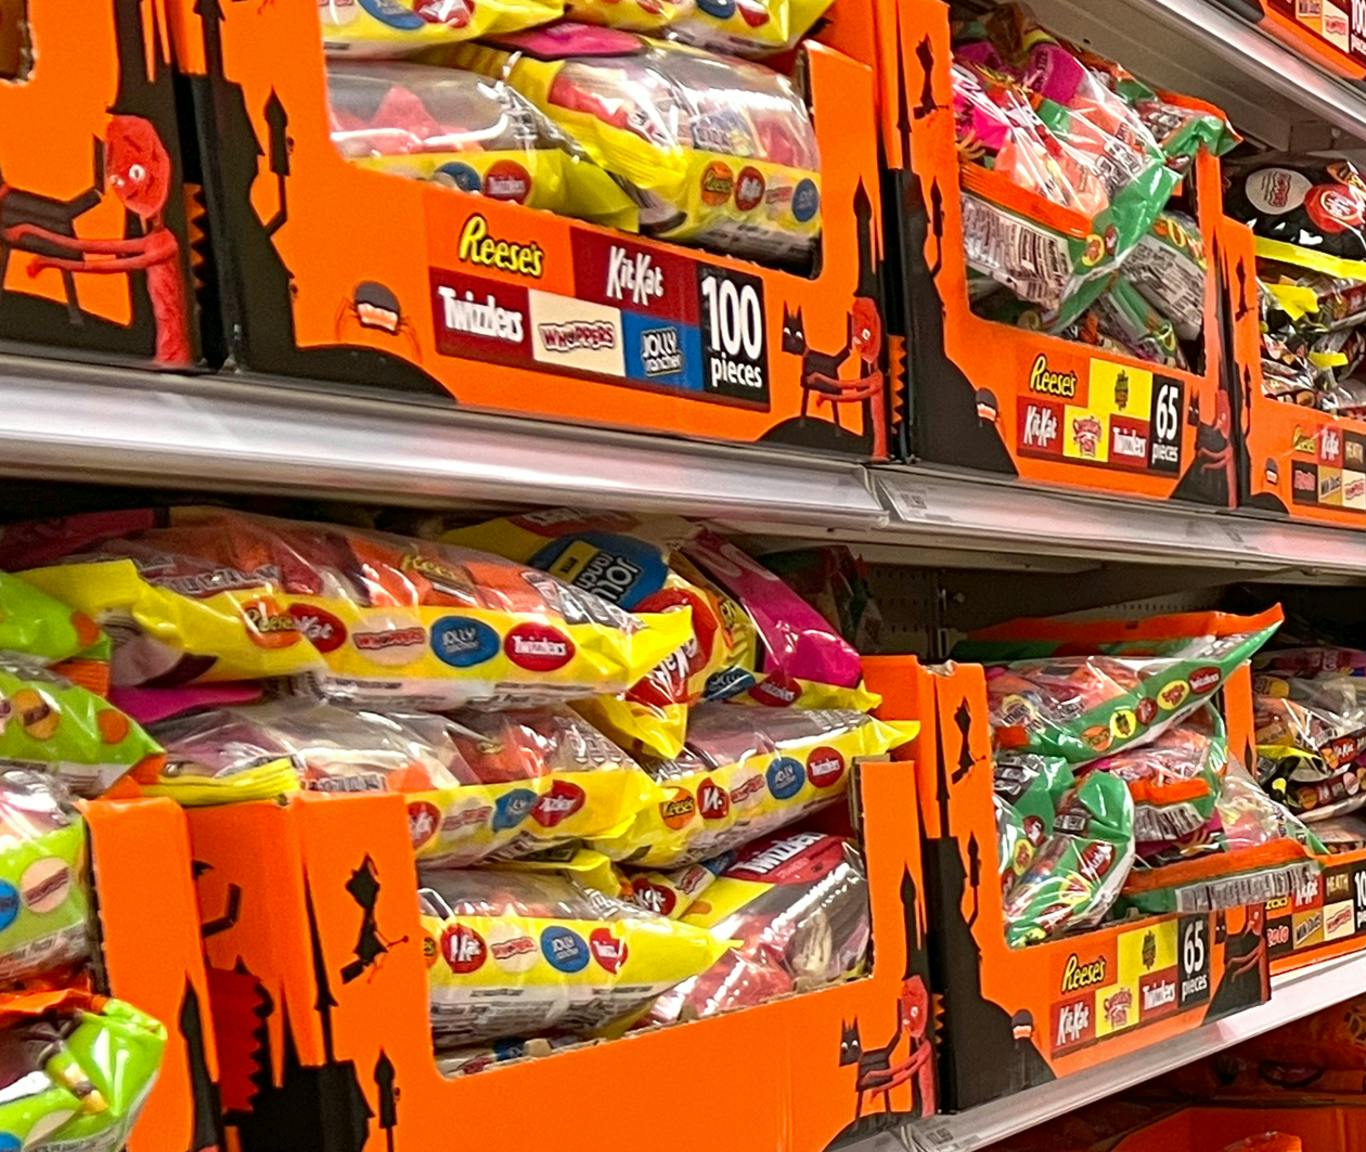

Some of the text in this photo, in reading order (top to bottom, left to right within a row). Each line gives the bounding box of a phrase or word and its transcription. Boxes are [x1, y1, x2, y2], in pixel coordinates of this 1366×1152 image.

[459, 213, 543, 277] Reese's
[438, 286, 523, 343] Twizzlers
[701, 276, 761, 360] 100
[712, 357, 762, 388] pieces
[1030, 355, 1076, 398] Reese's
[1156, 385, 1178, 441] 65
[1152, 439, 1178, 464] pieces
[1184, 920, 1204, 975] 65
[1062, 954, 1105, 995] Reese's
[1182, 972, 1207, 1002] pieces
